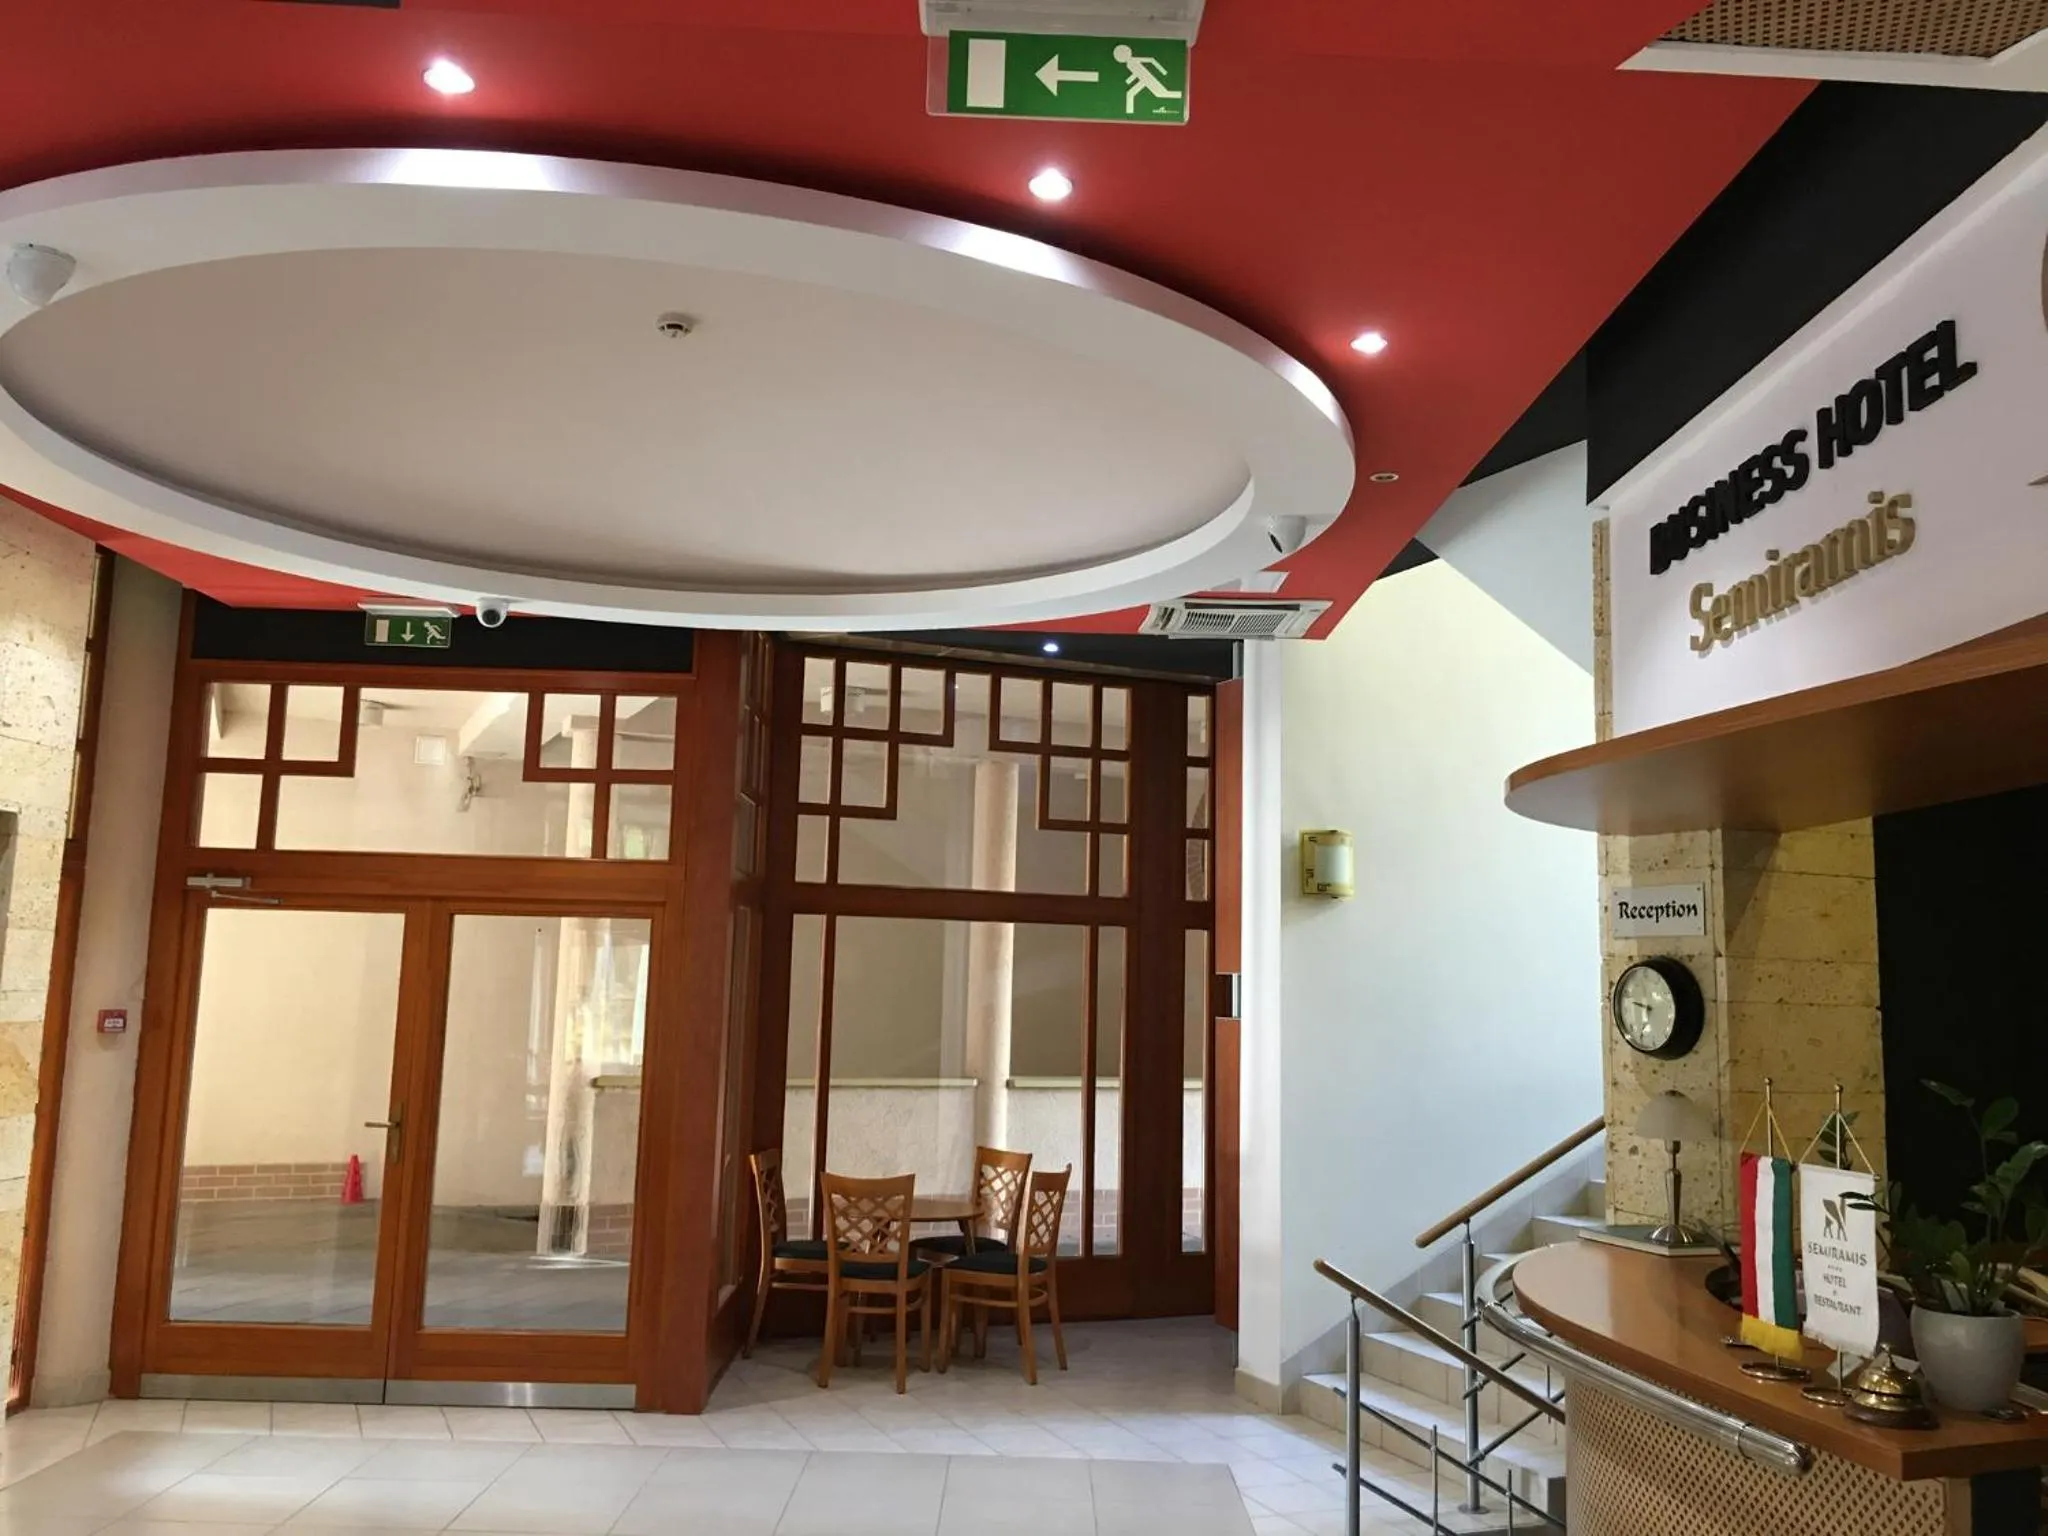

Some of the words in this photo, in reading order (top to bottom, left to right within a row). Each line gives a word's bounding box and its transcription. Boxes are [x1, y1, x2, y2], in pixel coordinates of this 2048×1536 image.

[1816, 320, 1977, 469] HOTEL
[1689, 490, 1916, 652] Semiramis
[1618, 900, 1698, 923] Reception
[1807, 1241, 1868, 1267] SEMIRAMIS
[1823, 1273, 1847, 1289] HOTEL
